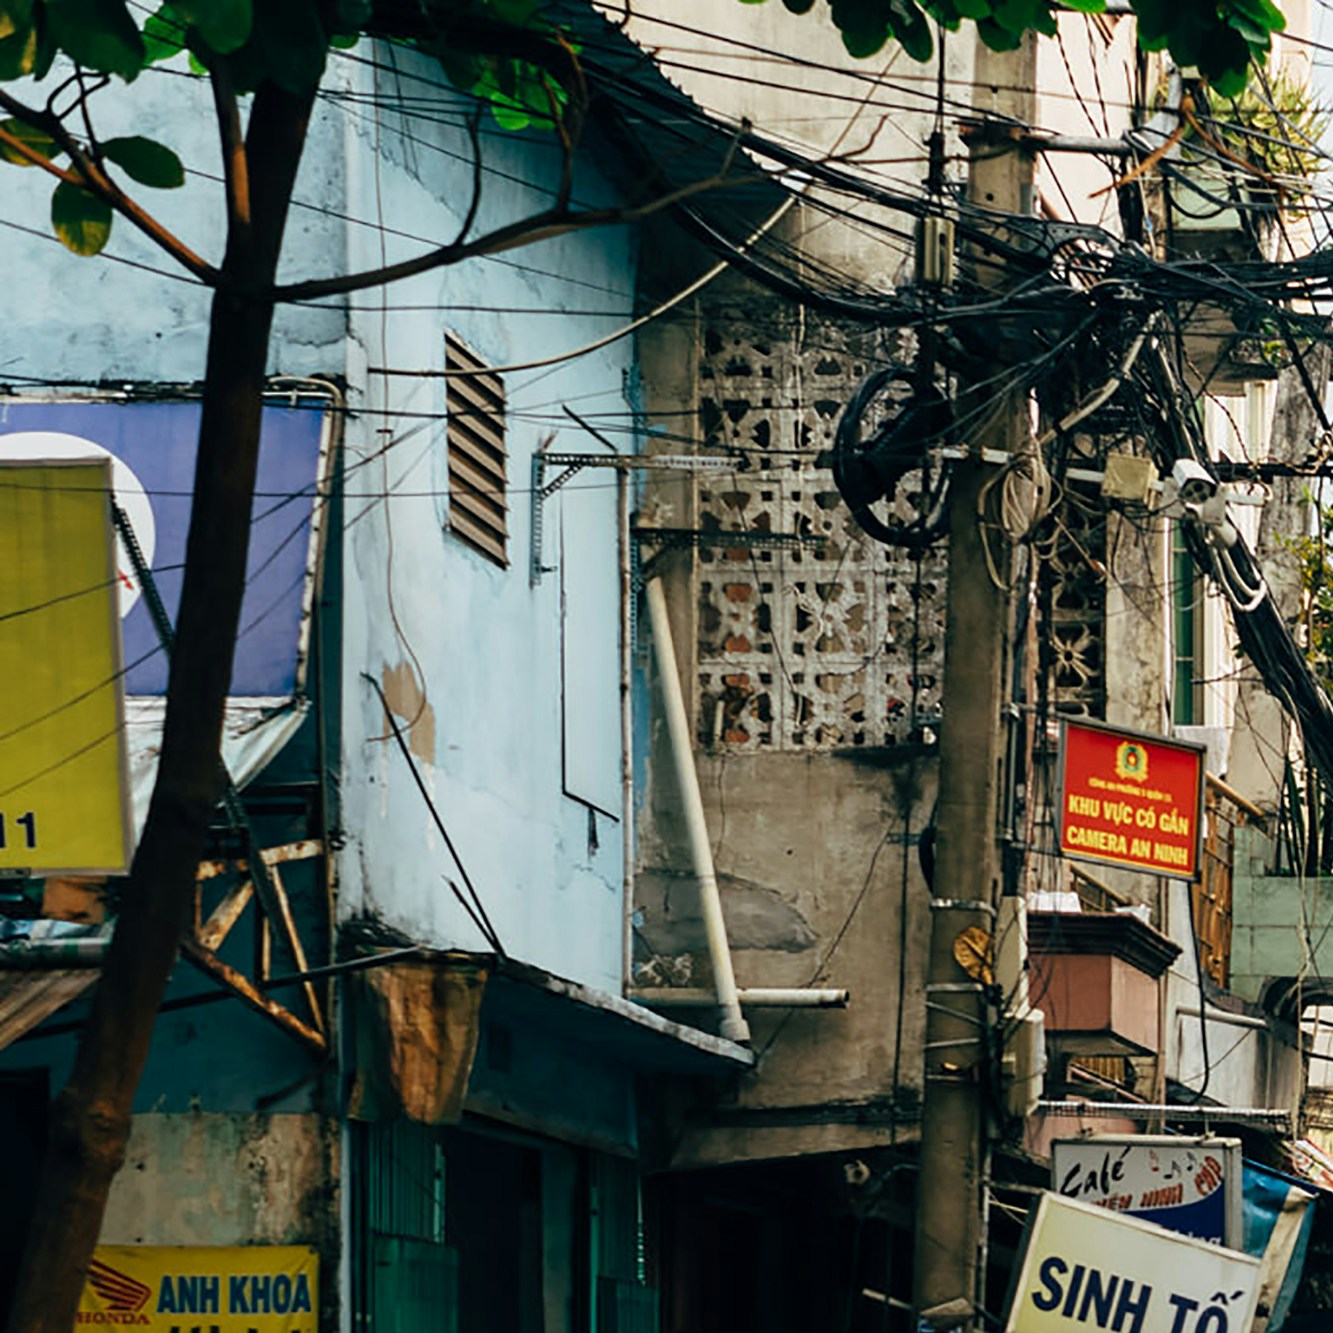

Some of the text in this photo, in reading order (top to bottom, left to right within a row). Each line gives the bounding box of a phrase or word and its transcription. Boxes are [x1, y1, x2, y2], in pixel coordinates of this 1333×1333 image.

[1068, 795, 1189, 836] KHU VỰC CÓ GẮN
[1067, 825, 1188, 866] CAMERA AN NINH
[1060, 1146, 1133, 1199] Café
[156, 1273, 312, 1315] ANH KHOA
[76, 1310, 150, 1326] HONDA
